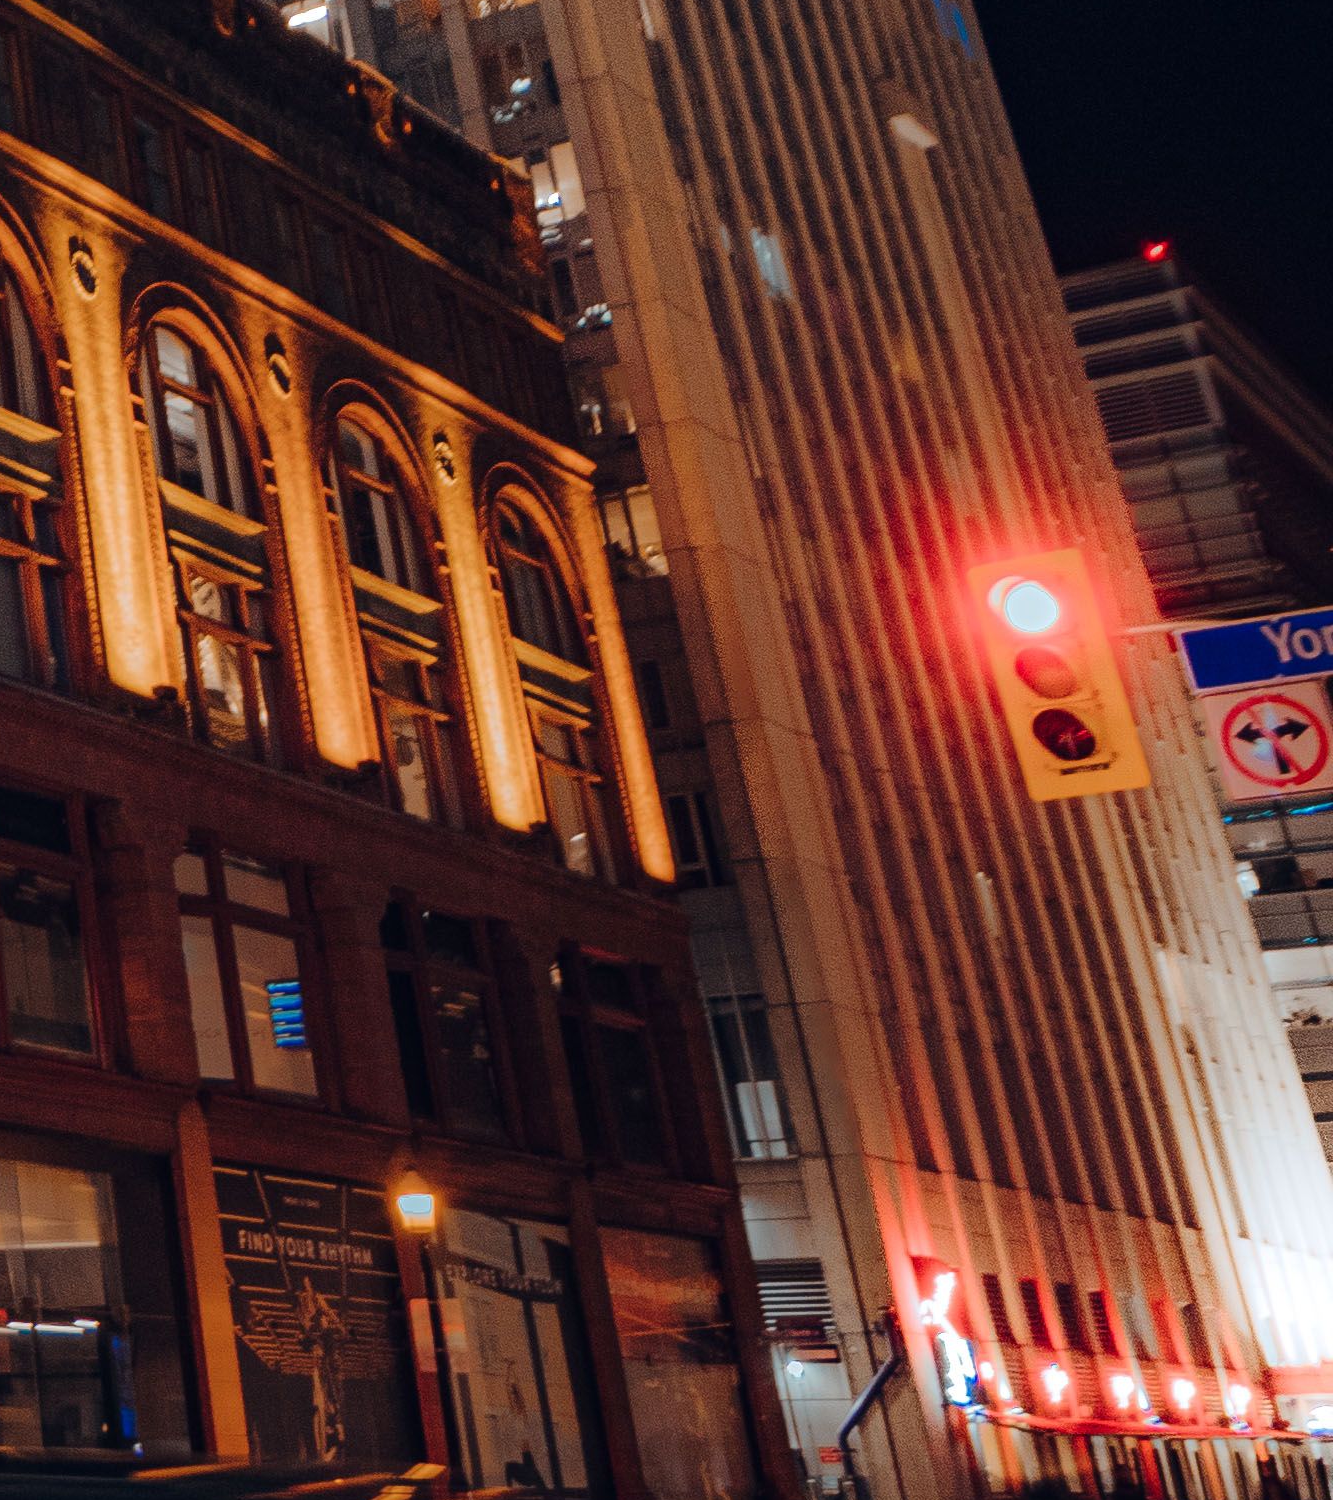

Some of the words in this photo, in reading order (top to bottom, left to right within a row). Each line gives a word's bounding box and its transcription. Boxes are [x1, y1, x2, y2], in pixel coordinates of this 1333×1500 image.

[239, 1229, 273, 1253] FIND
[276, 1235, 315, 1259] YOUR
[318, 1241, 374, 1265] RHYTHM
